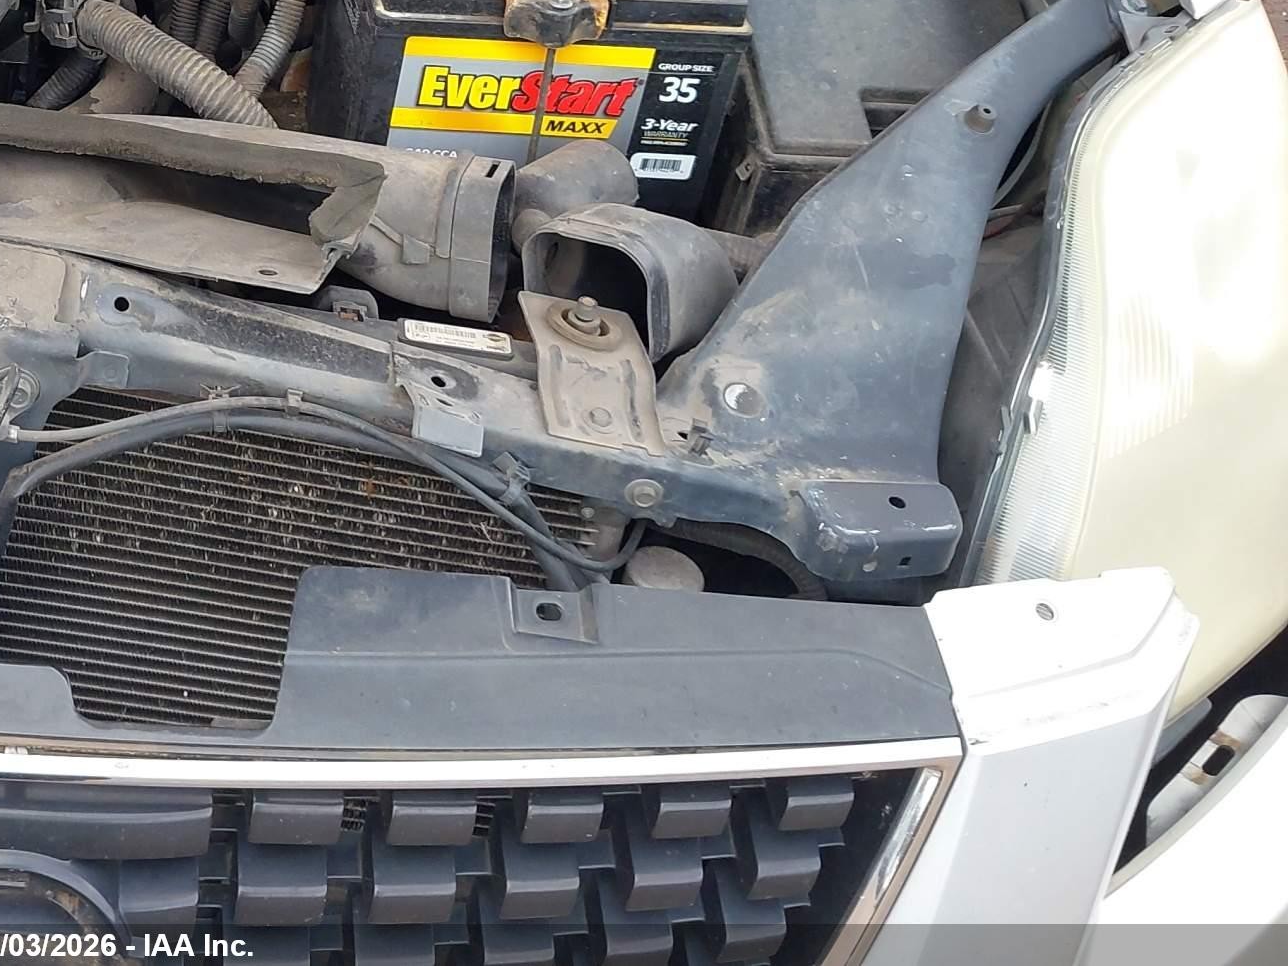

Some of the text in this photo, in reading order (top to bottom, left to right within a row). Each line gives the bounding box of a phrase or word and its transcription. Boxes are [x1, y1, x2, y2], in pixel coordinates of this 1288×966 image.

[658, 63, 715, 73] GROUP SIZE
[416, 64, 639, 117] EverStart
[658, 76, 701, 103] 35
[544, 119, 608, 135] MAXX
[640, 118, 699, 133] 3-Year
